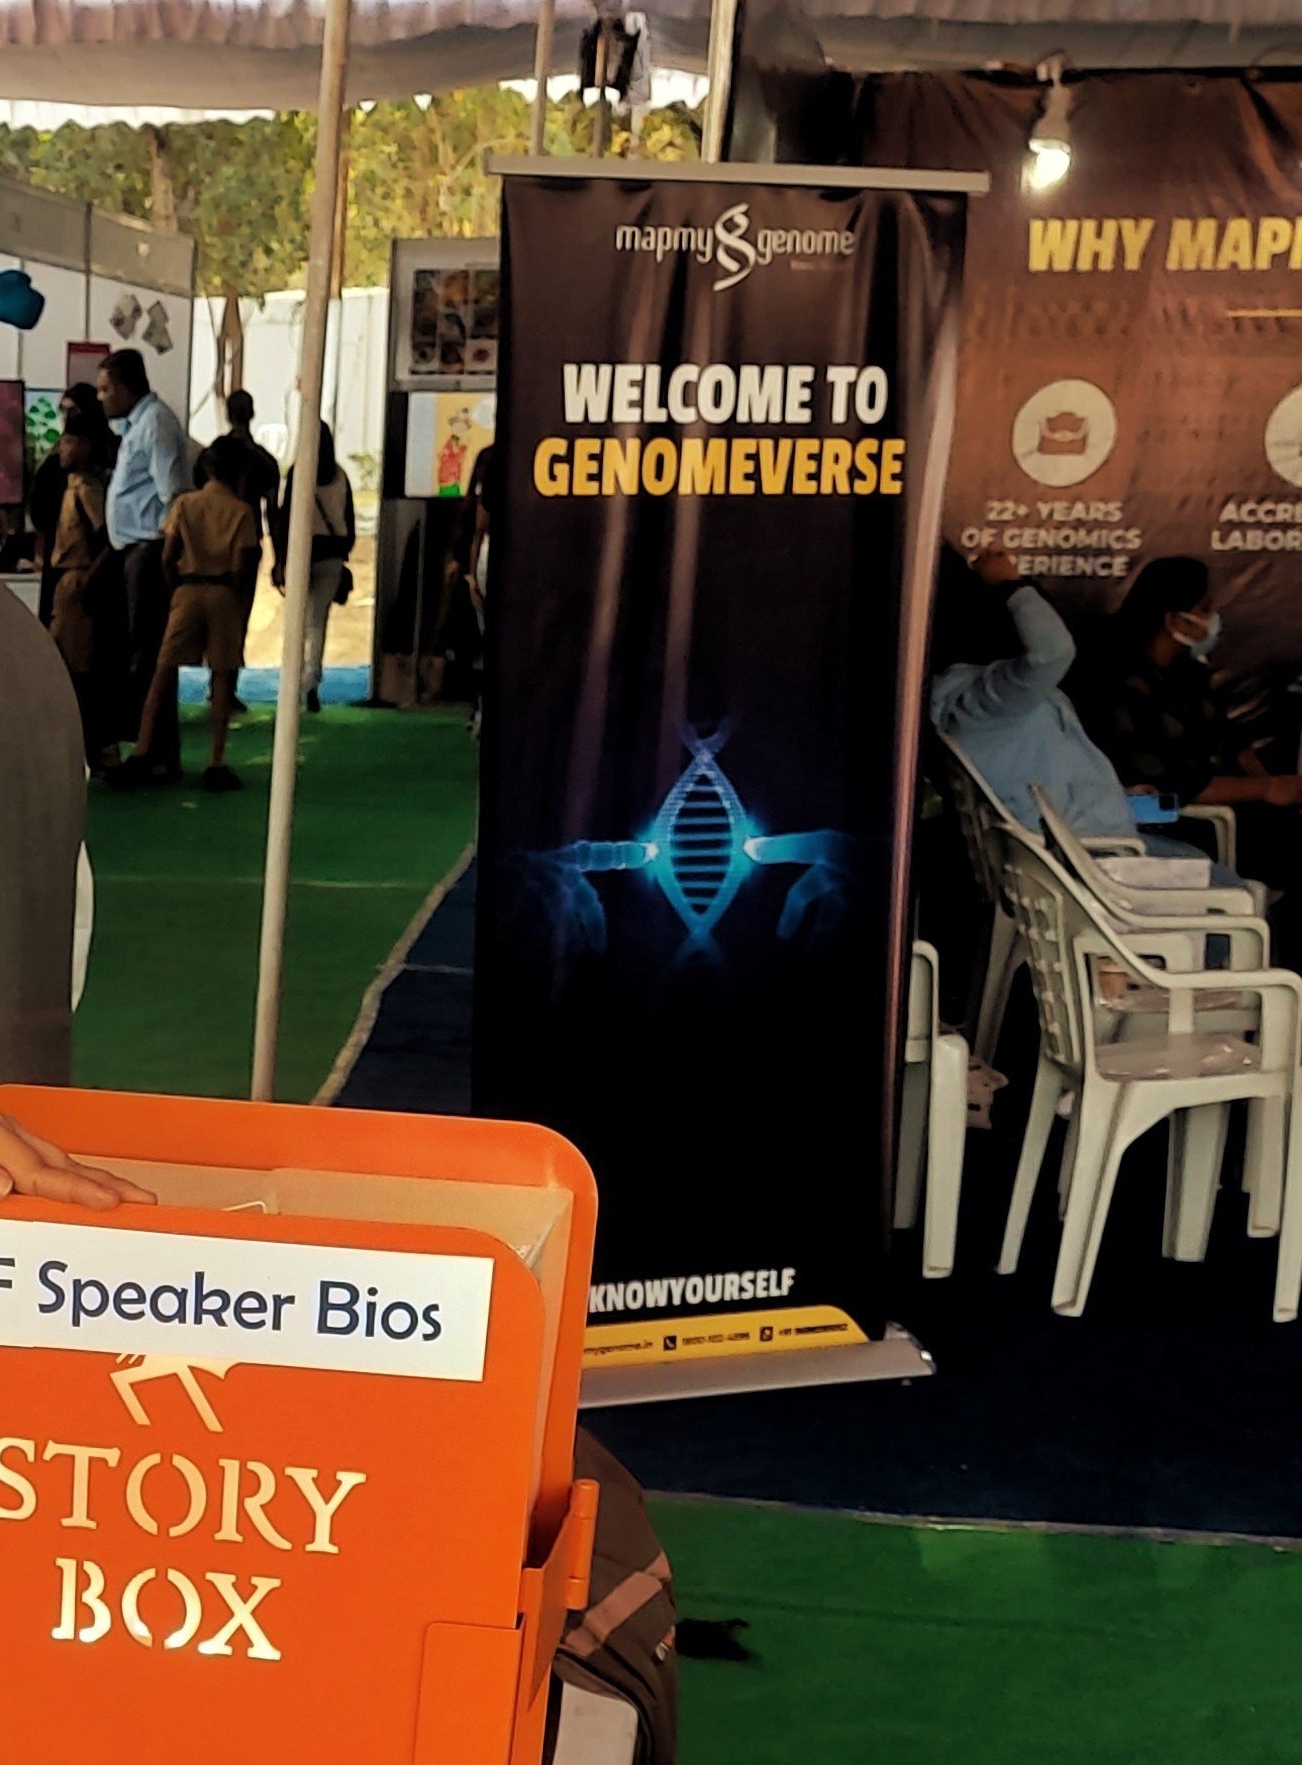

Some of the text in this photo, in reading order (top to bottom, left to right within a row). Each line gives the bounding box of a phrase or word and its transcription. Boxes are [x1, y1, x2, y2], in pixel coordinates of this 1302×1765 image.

[1028, 218, 1155, 272] WHY
[563, 362, 889, 425] WELCOME TO
[533, 437, 906, 497] GENOMEVERSE
[960, 528, 1144, 550] OF GENOMICS
[986, 501, 1124, 522] 22+ YEARS
[37, 1259, 296, 1333] Speaker
[316, 1280, 443, 1342] Bios
[51, 1557, 282, 1661] BOX
